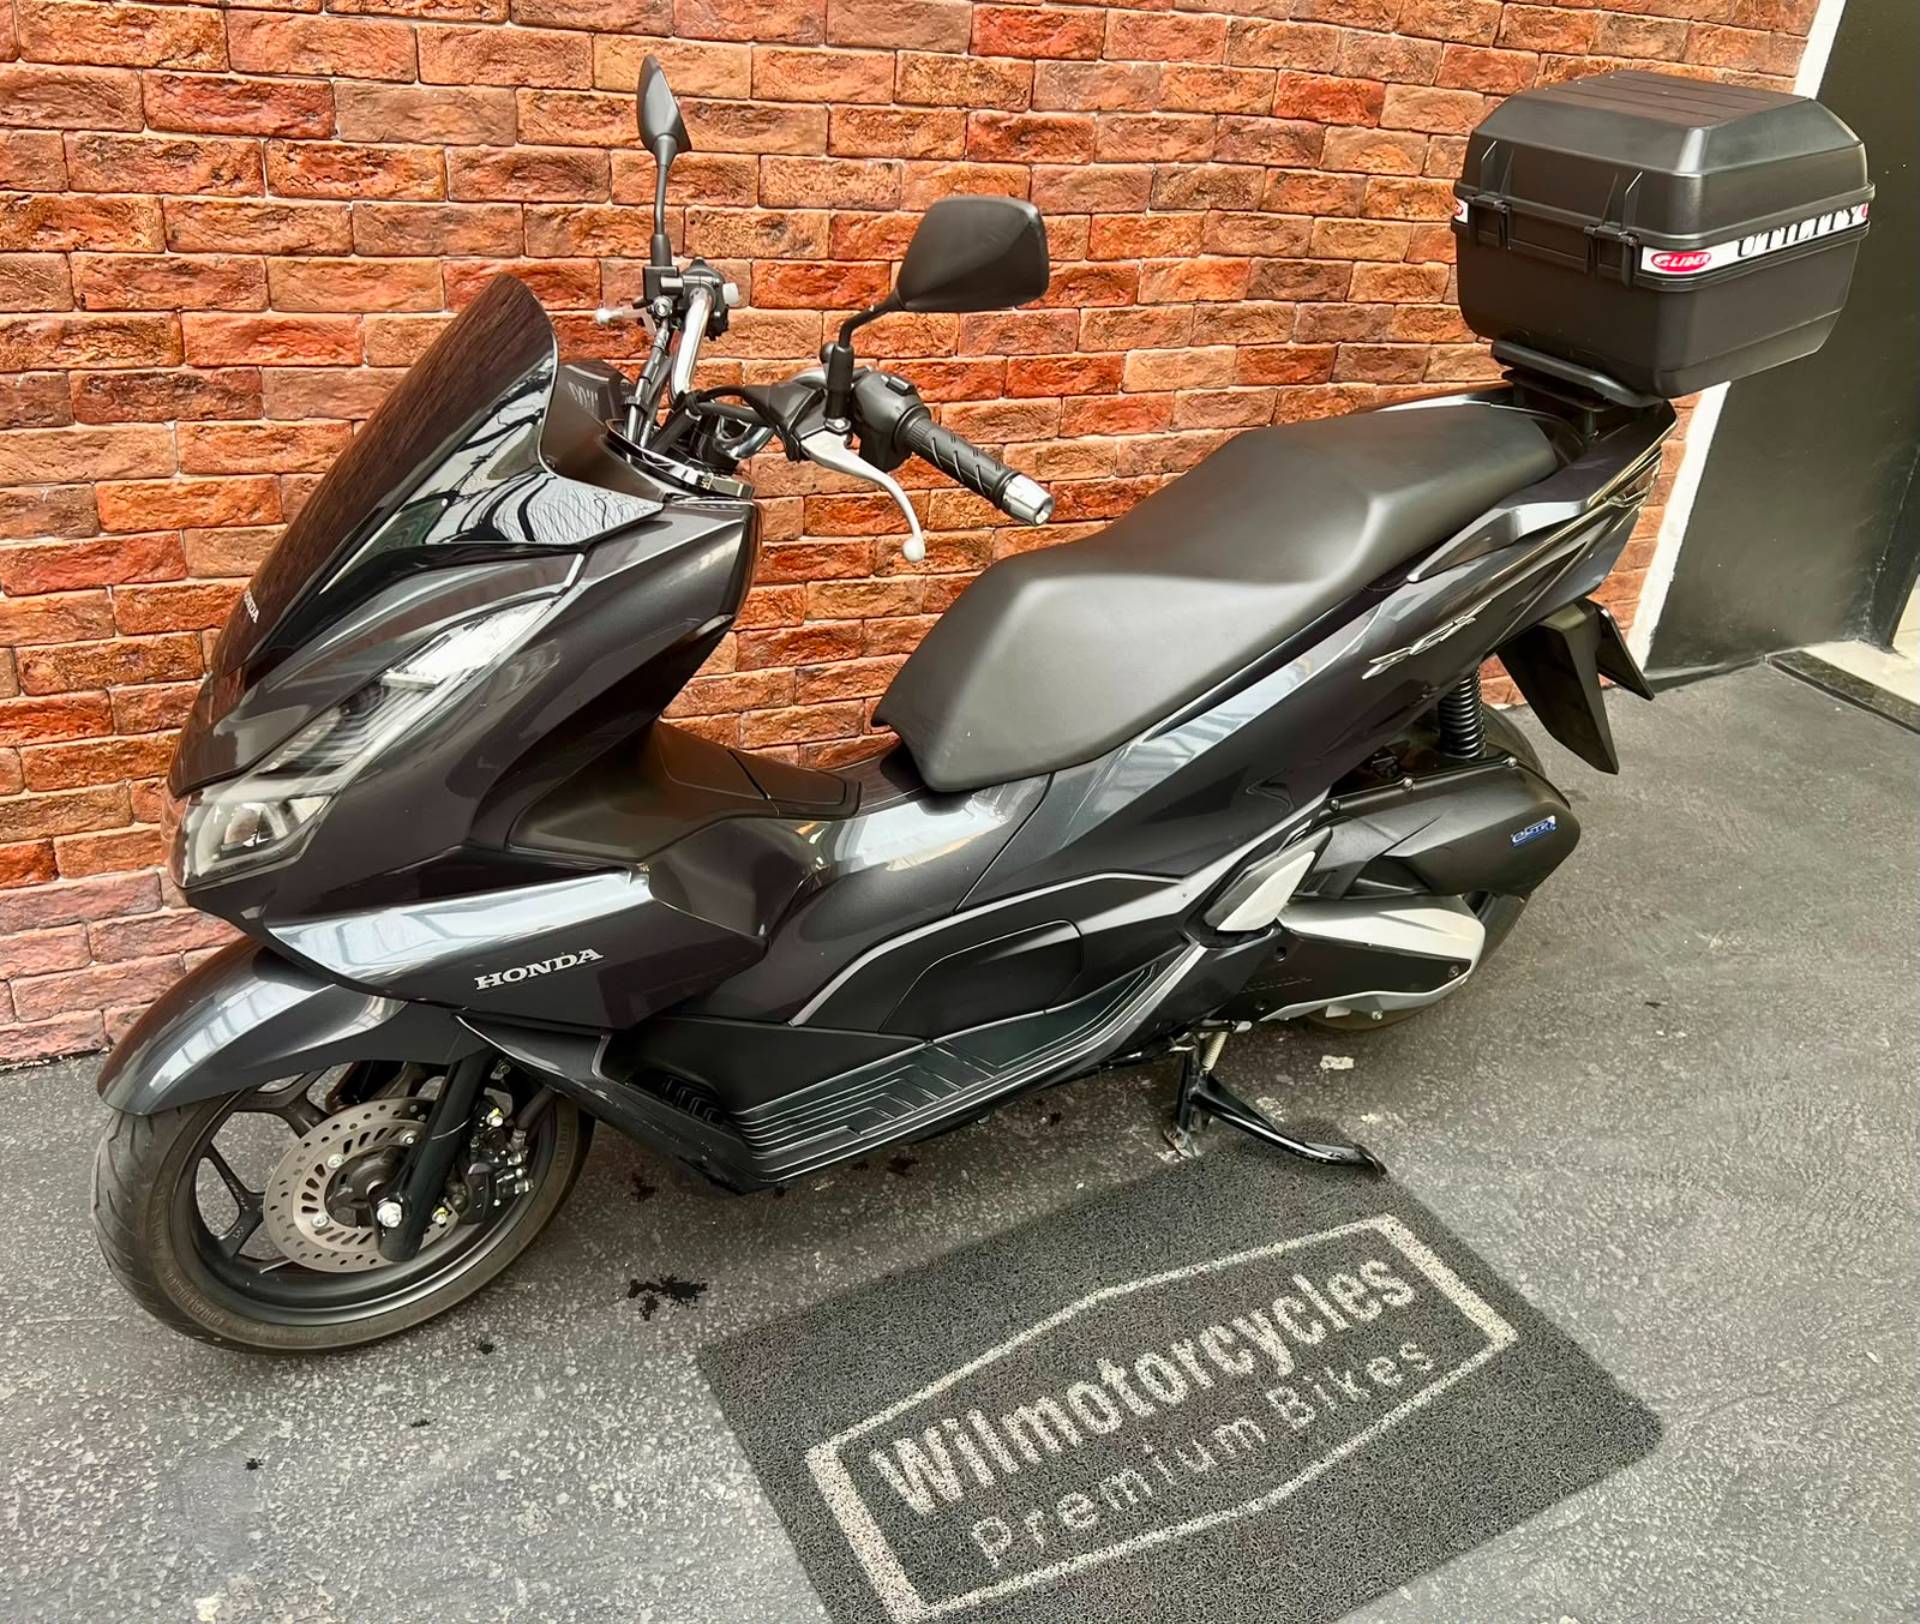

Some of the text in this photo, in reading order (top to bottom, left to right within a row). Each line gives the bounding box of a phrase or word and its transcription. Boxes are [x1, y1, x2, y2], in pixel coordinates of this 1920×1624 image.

[1737, 206, 1860, 257] UTILITY
[474, 948, 604, 990] HONDA
[867, 1260, 1415, 1515] Wilmotorcycles
[970, 1341, 1434, 1569] Premium Bikes
